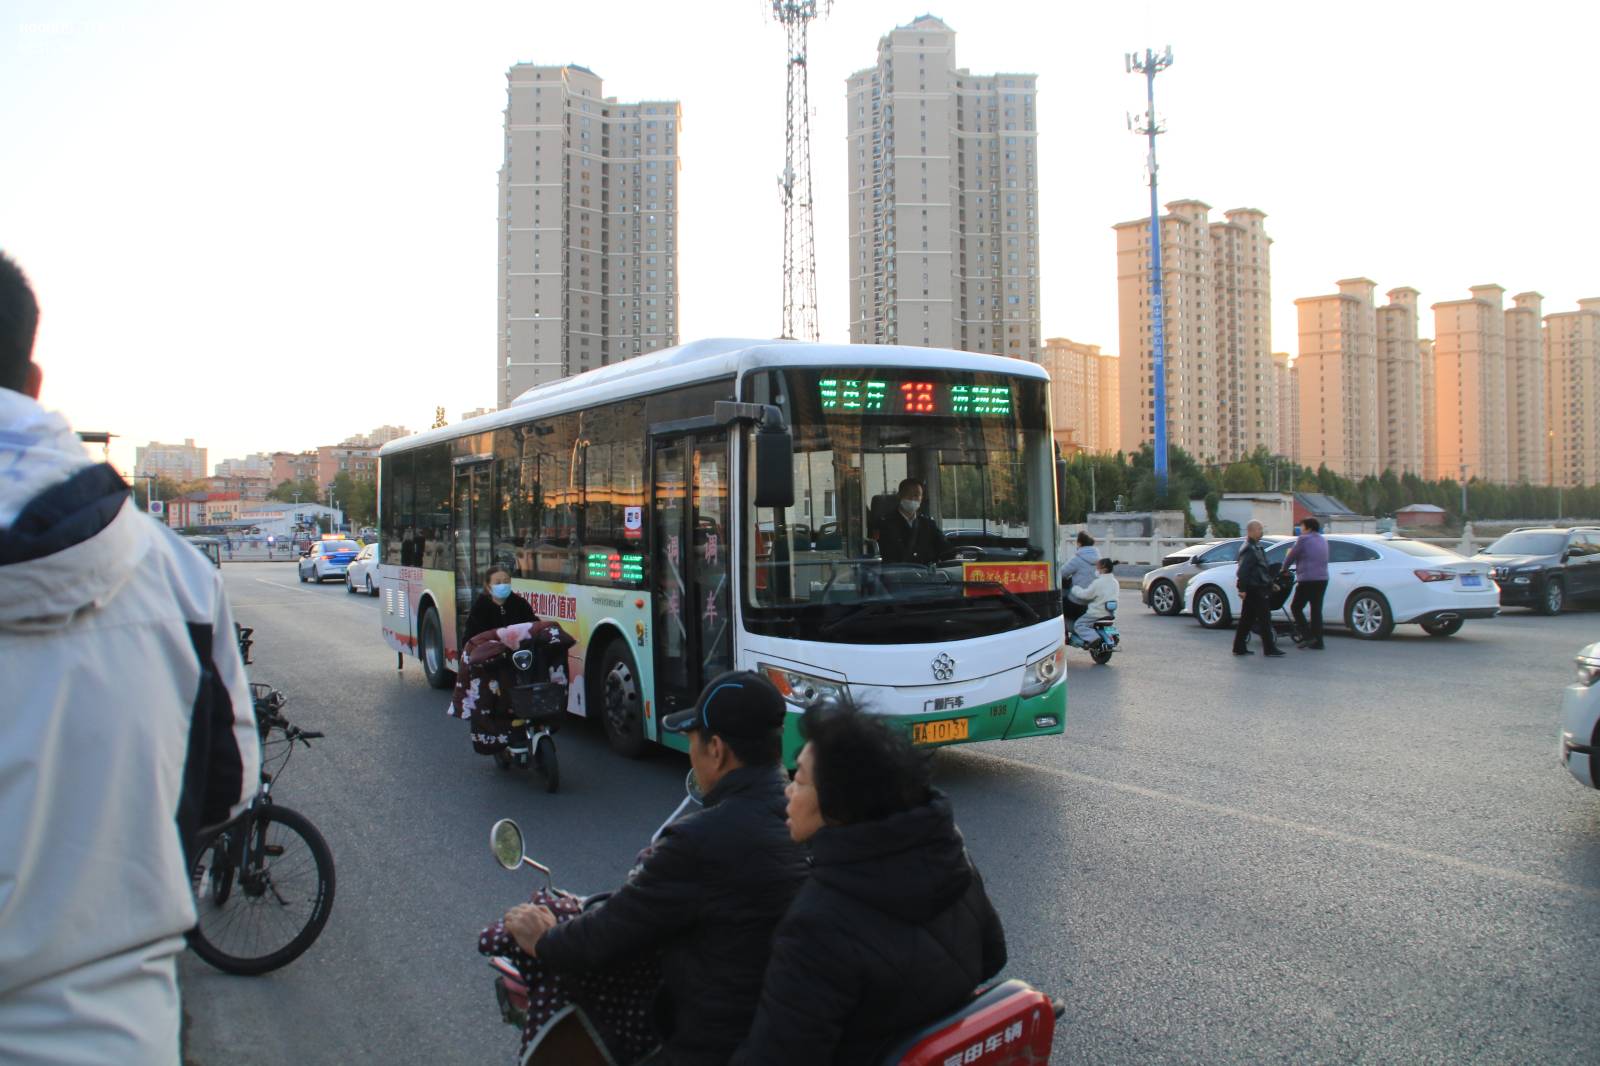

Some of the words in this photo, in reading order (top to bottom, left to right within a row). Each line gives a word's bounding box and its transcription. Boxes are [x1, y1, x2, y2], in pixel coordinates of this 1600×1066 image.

[513, 591, 577, 620] 核心价值观
